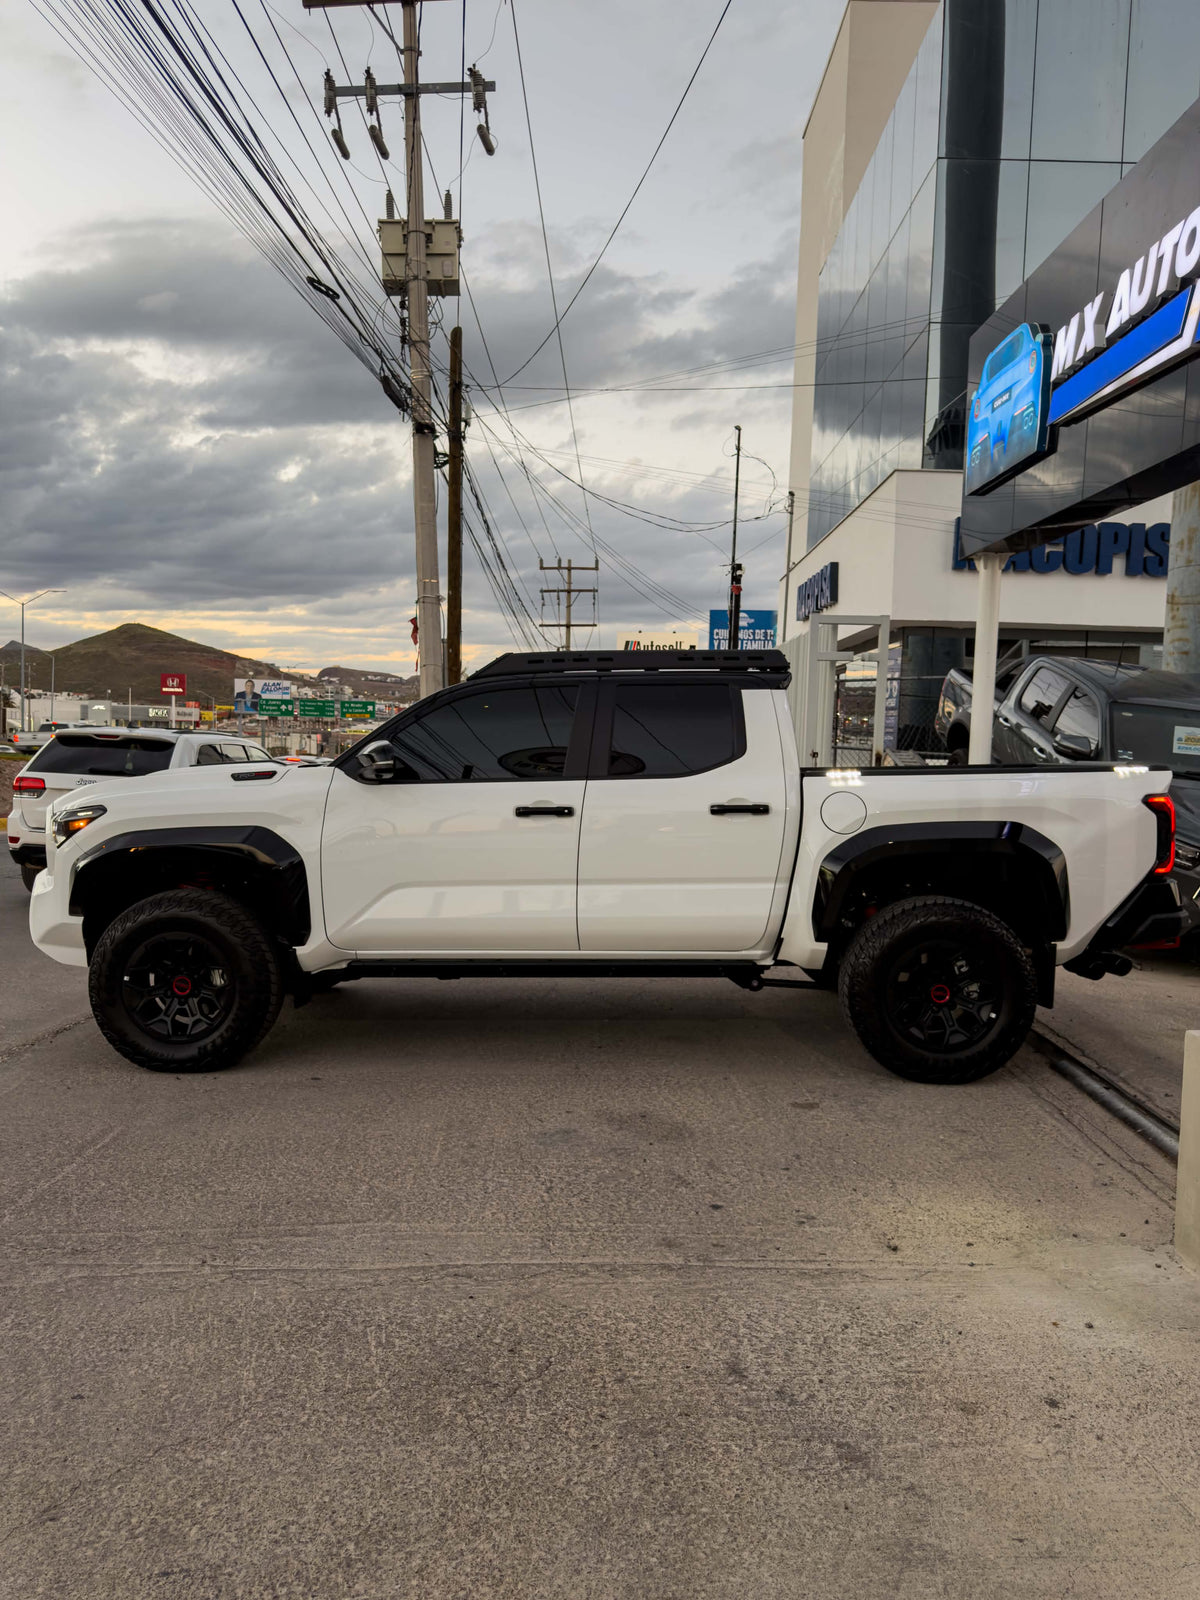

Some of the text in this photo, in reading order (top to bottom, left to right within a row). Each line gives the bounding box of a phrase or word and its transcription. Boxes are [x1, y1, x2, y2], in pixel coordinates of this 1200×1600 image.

[1050, 206, 1200, 383] MX AUTO
[952, 516, 1171, 578] COPIS
[713, 640, 719, 650] Y
[742, 640, 774, 650] FAMILIA
[754, 629, 765, 640] DE
